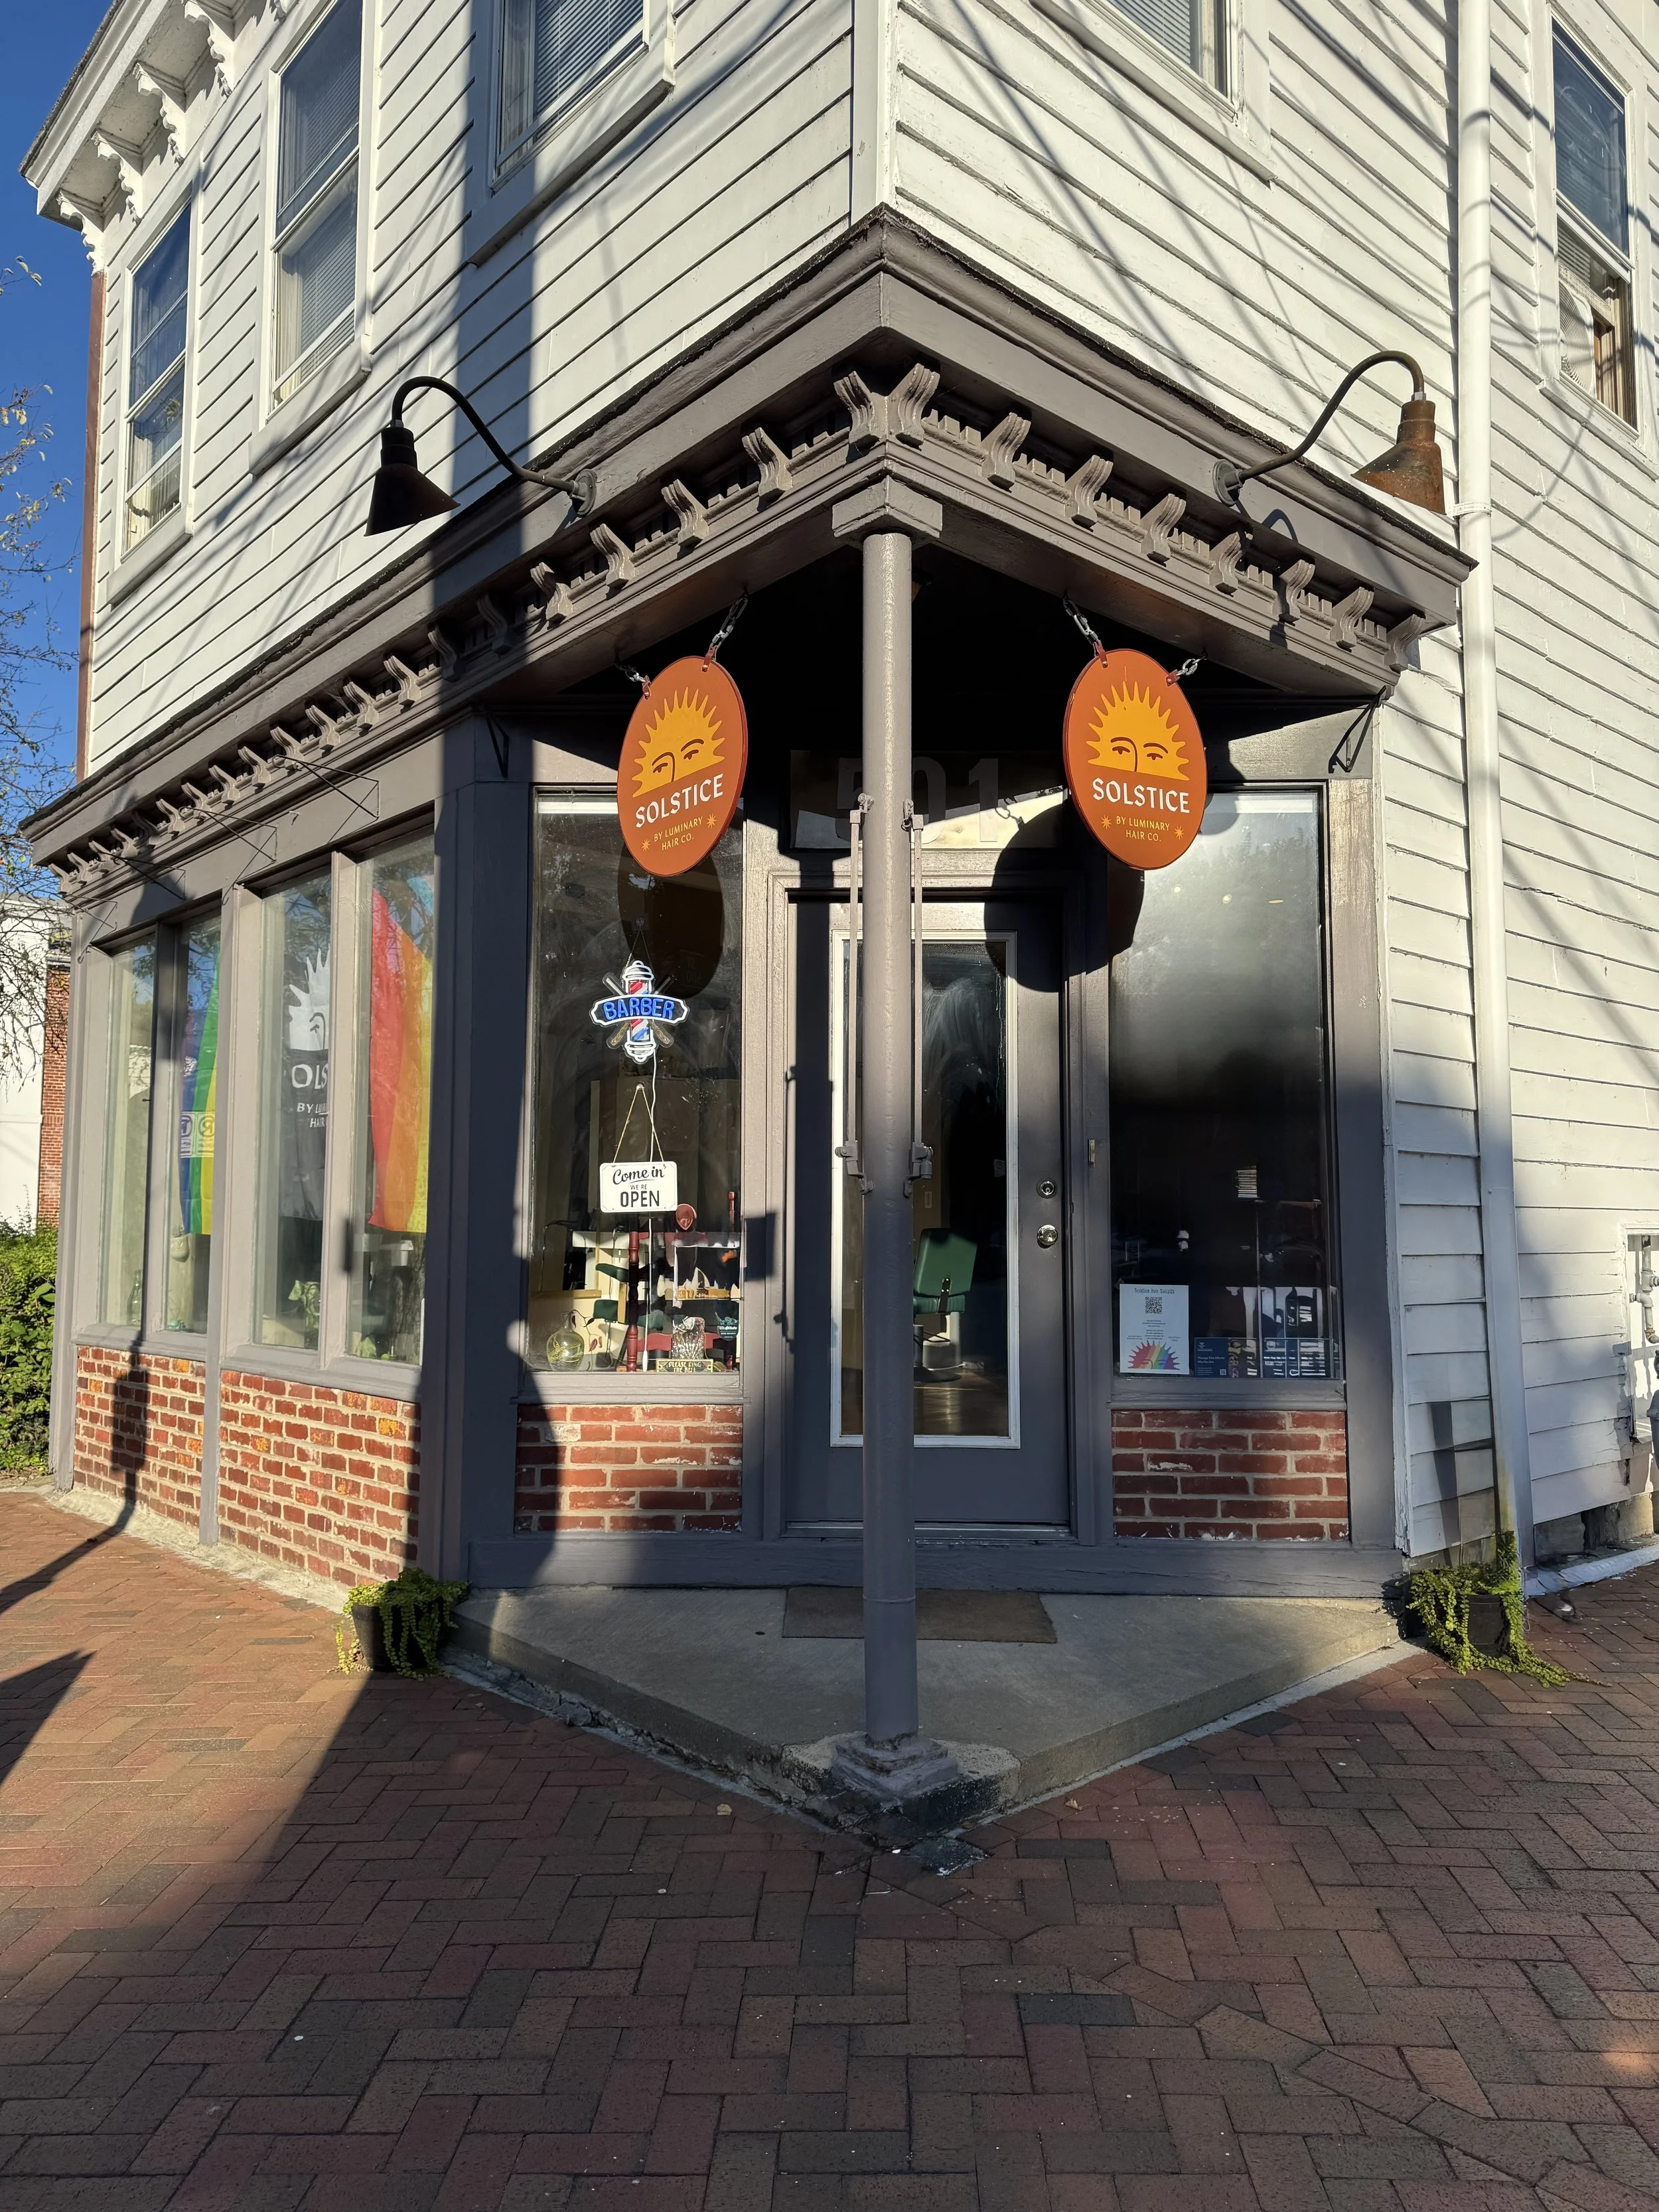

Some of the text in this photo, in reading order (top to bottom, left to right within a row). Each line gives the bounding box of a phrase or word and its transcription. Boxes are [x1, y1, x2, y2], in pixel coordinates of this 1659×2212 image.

[635, 773, 724, 828] SOLSTICE
[1092, 777, 1190, 814] SOLSTICE
[654, 816, 703, 842] BY LUMINARY
[1116, 816, 1170, 831] BY LUMINARY
[662, 834, 694, 851] HAIR CO.
[1125, 830, 1161, 842] HAIR CO.
[603, 997, 675, 1021] BARBER
[297, 1102, 313, 1114] BY
[309, 1117, 325, 1128] HAIR
[613, 1166, 664, 1185] Come in
[620, 1190, 660, 1208] OPEN
